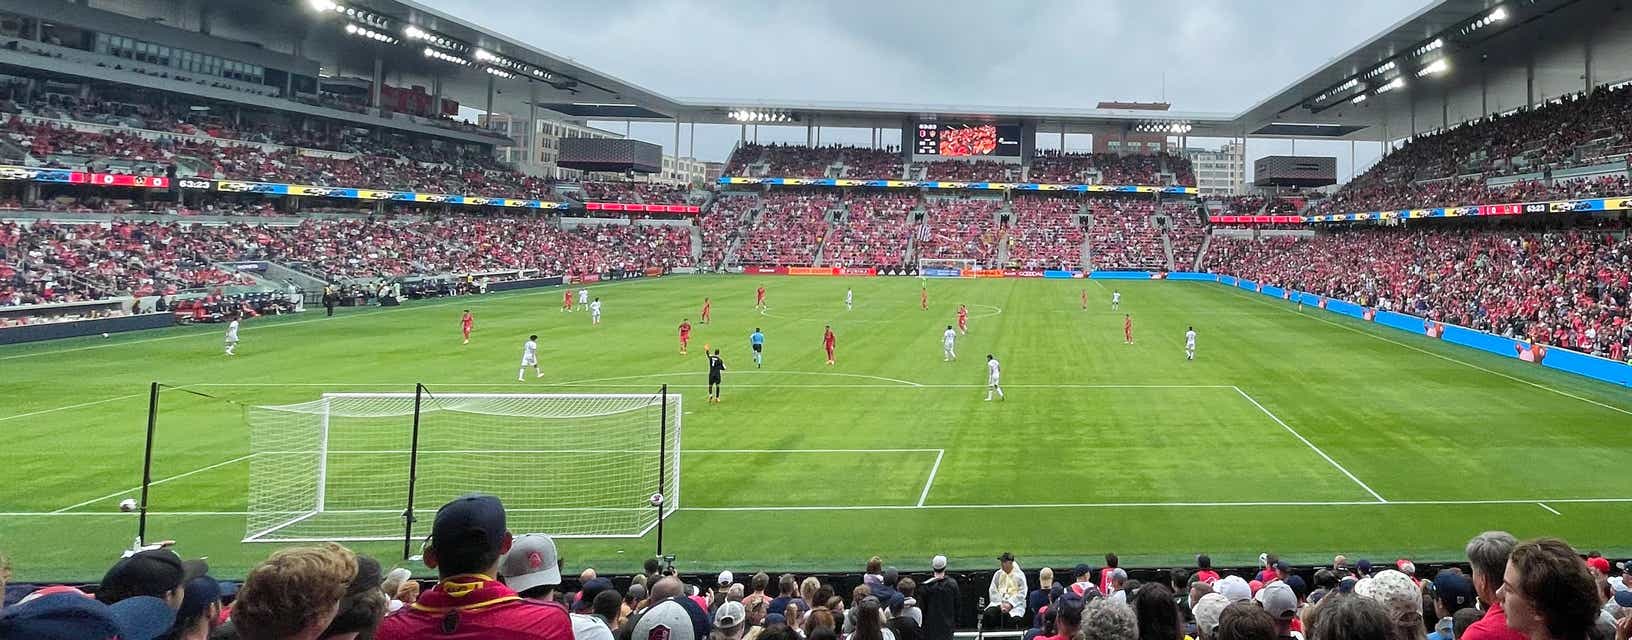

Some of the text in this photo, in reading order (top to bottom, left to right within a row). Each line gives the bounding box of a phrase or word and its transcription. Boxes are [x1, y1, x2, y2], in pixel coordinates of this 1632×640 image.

[104, 175, 162, 186] 0 0
[179, 180, 210, 188] 63:23
